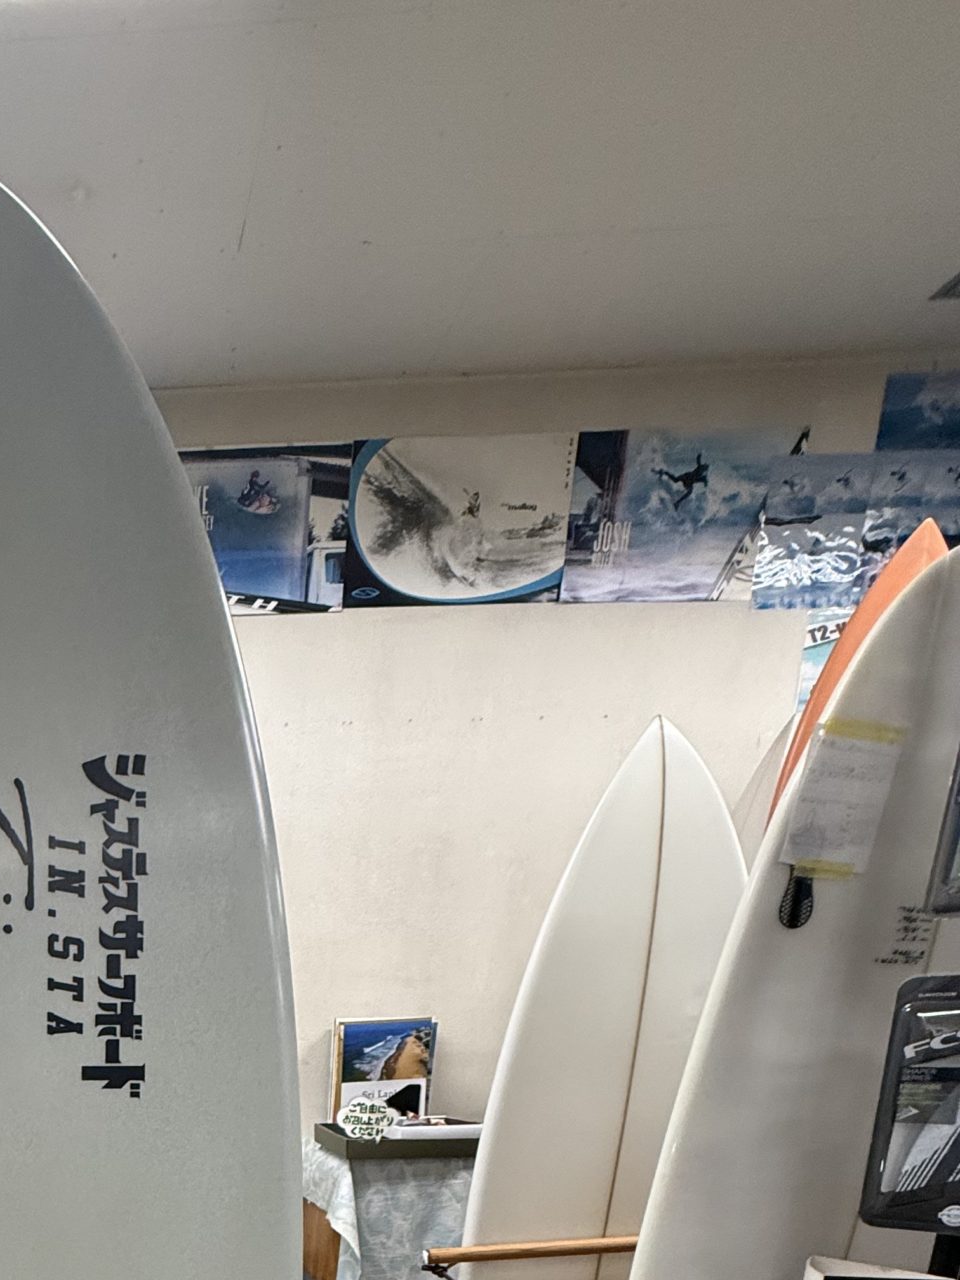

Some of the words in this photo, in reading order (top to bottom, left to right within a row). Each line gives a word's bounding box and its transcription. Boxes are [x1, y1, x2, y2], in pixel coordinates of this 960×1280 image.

[593, 518, 632, 553] JOSH
[47, 835, 86, 1036] IN.STA
[81, 754, 147, 1099] ジャスティスサーフボード
[903, 1029, 960, 1059] FC
